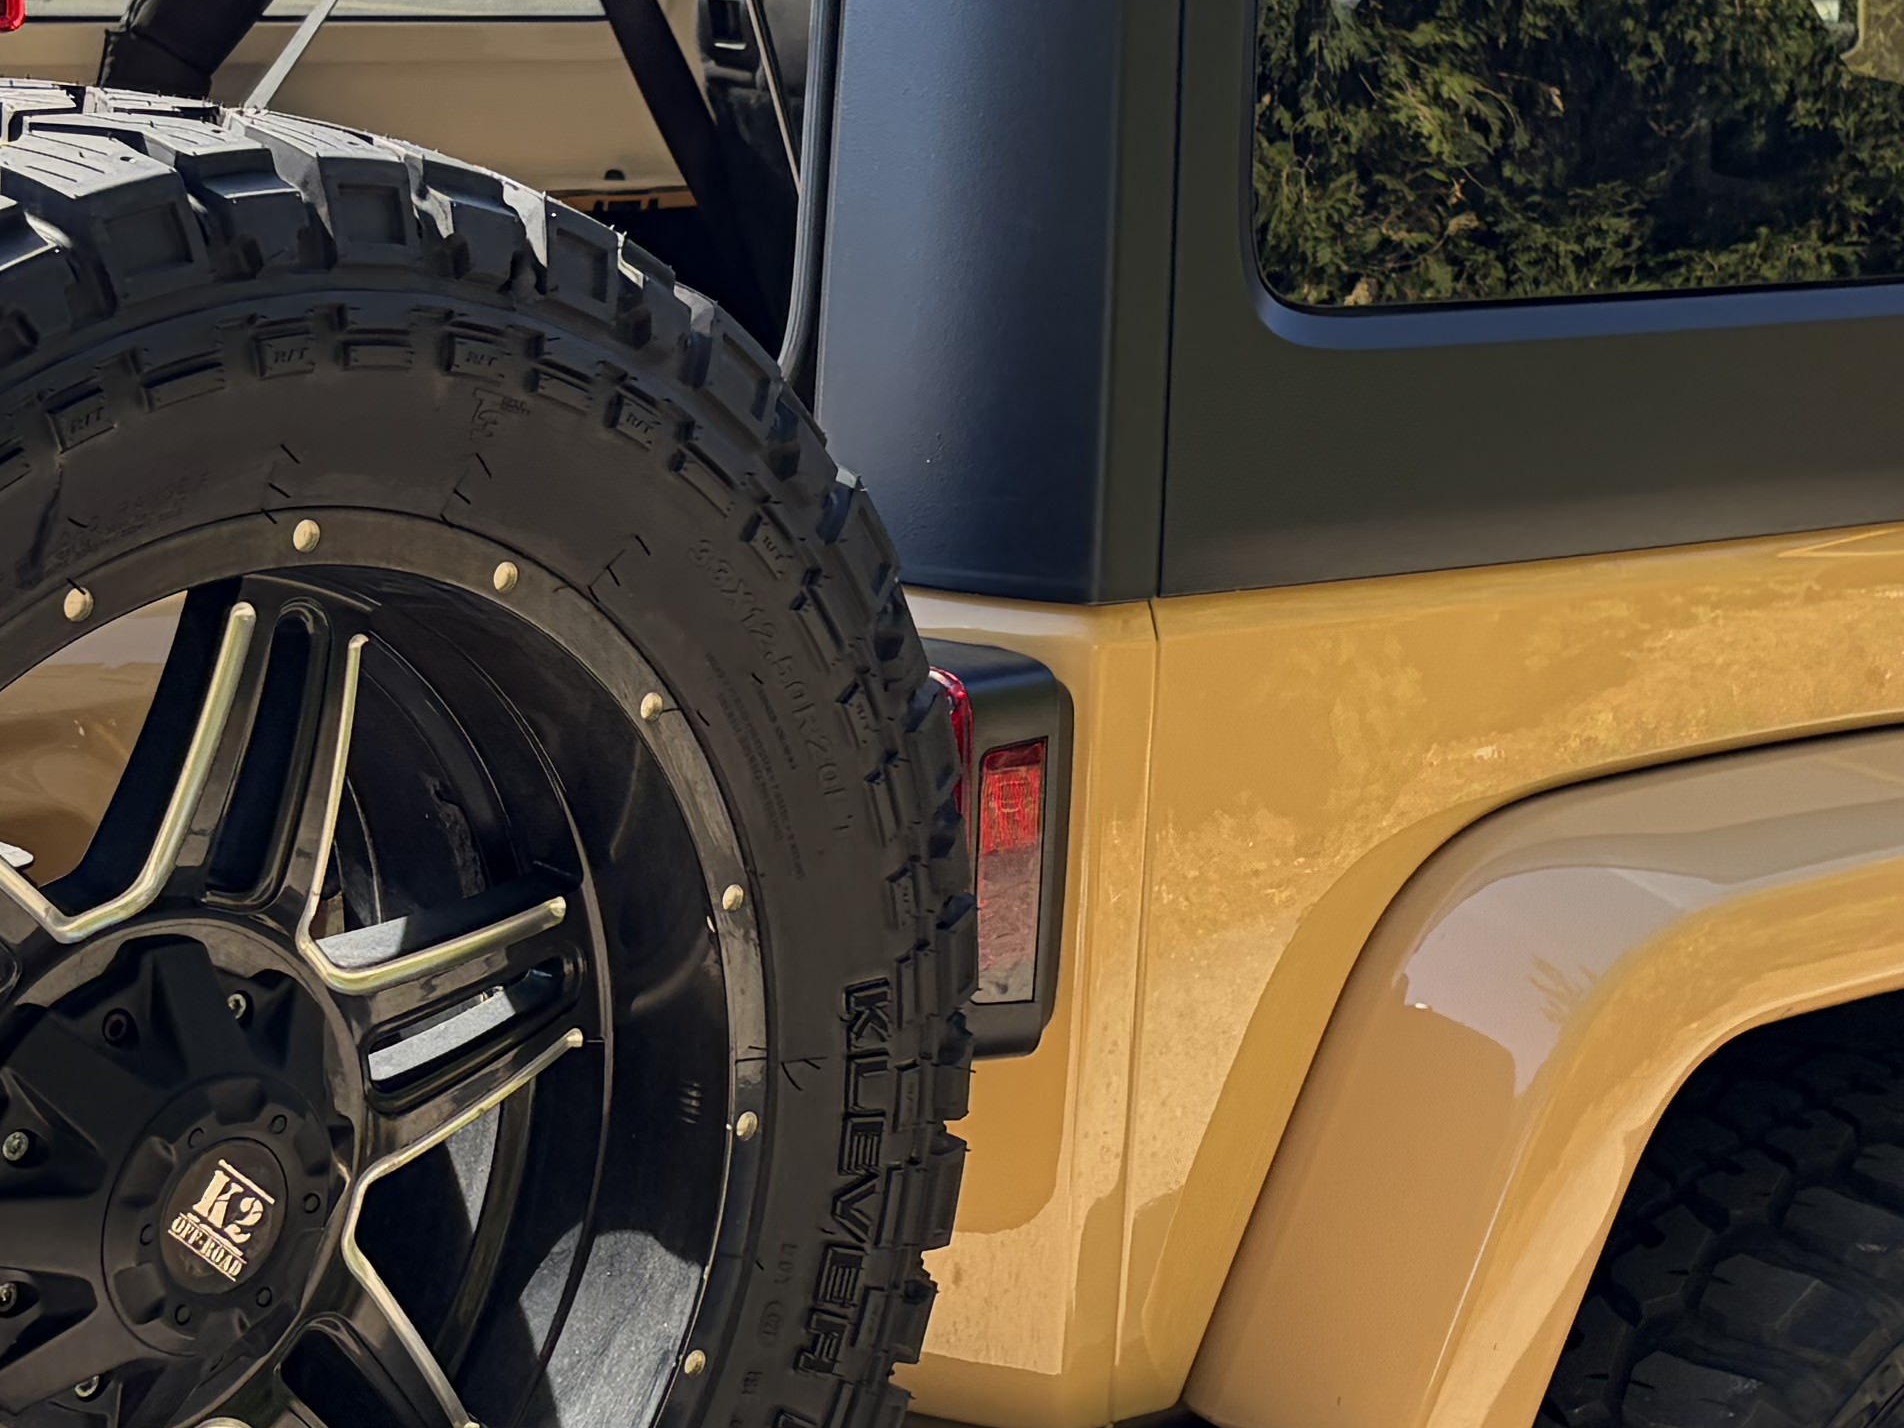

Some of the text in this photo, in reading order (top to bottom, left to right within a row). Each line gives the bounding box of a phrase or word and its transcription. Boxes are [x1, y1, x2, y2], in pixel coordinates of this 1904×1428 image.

[192, 1169, 265, 1244] K2
[793, 976, 893, 1375] KLEVER
[170, 1215, 245, 1278] OFF-ROAD
